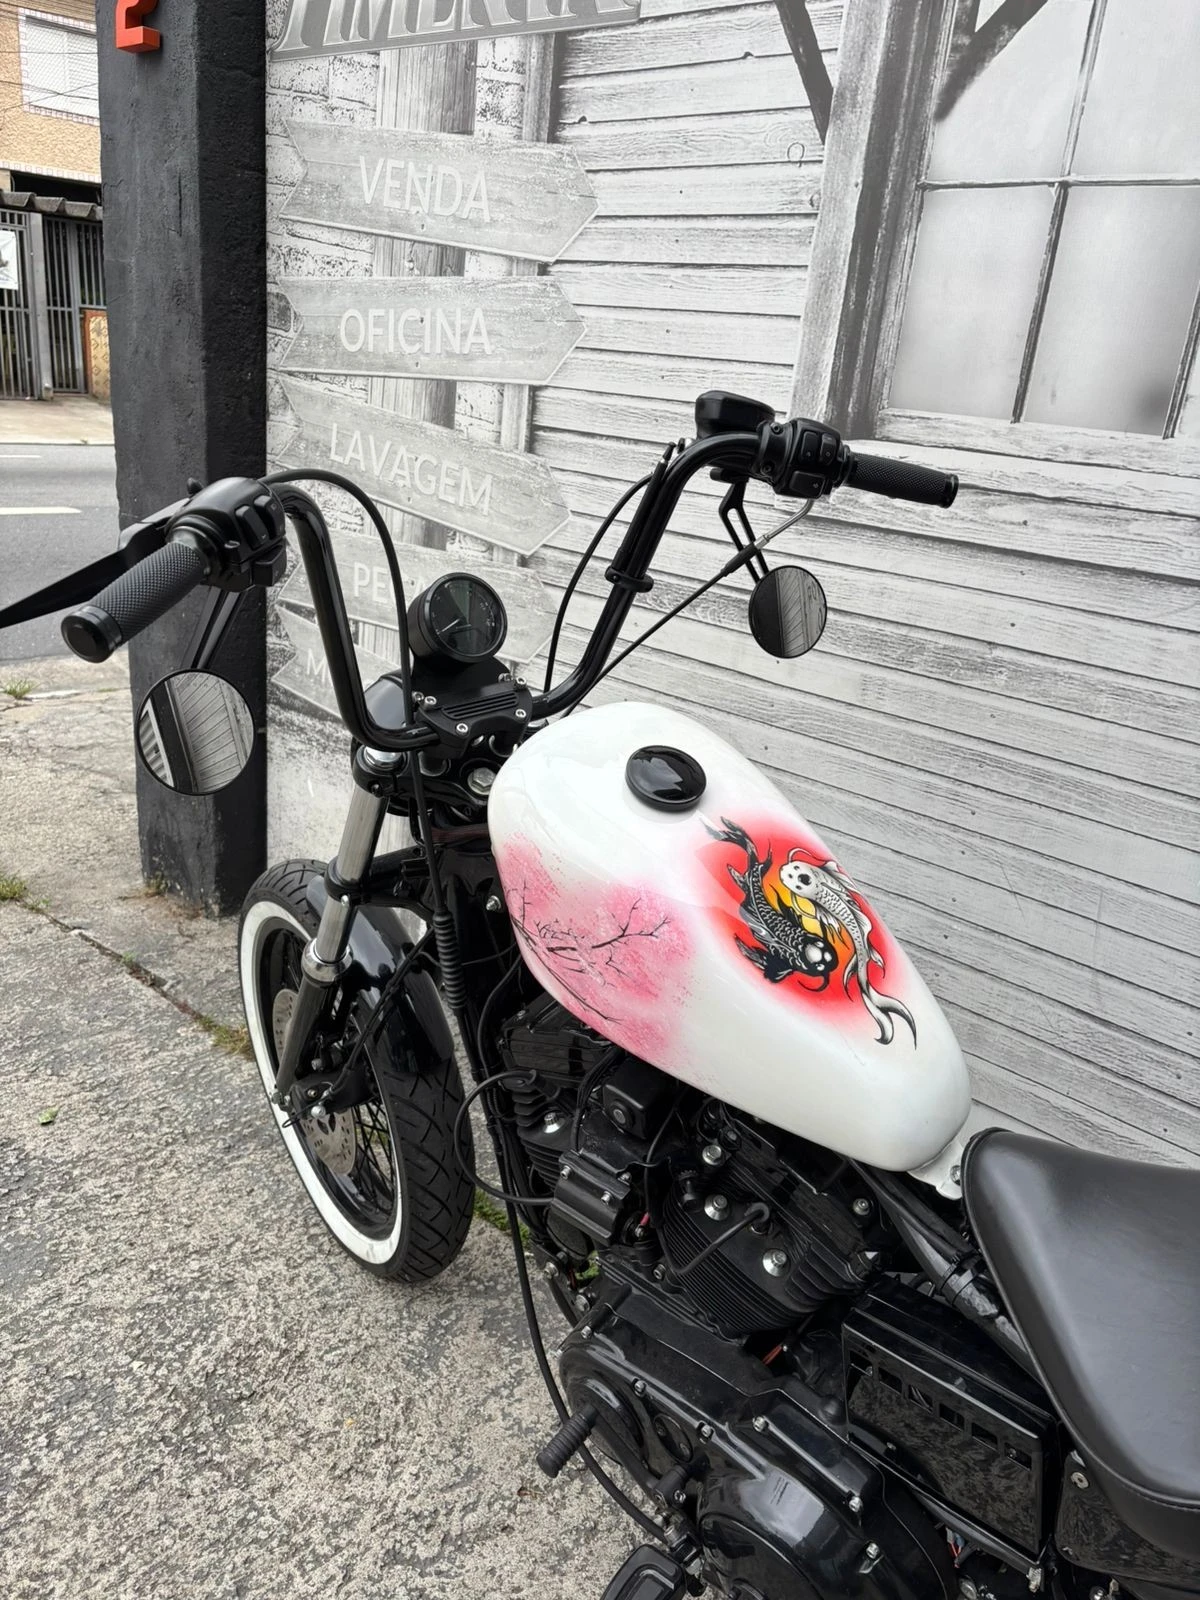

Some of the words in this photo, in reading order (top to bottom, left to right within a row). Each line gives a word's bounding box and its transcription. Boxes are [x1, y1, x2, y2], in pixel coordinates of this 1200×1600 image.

[359, 155, 491, 223] VENDA
[339, 307, 492, 355] OFICINA
[329, 423, 493, 516] LAVAGEM
